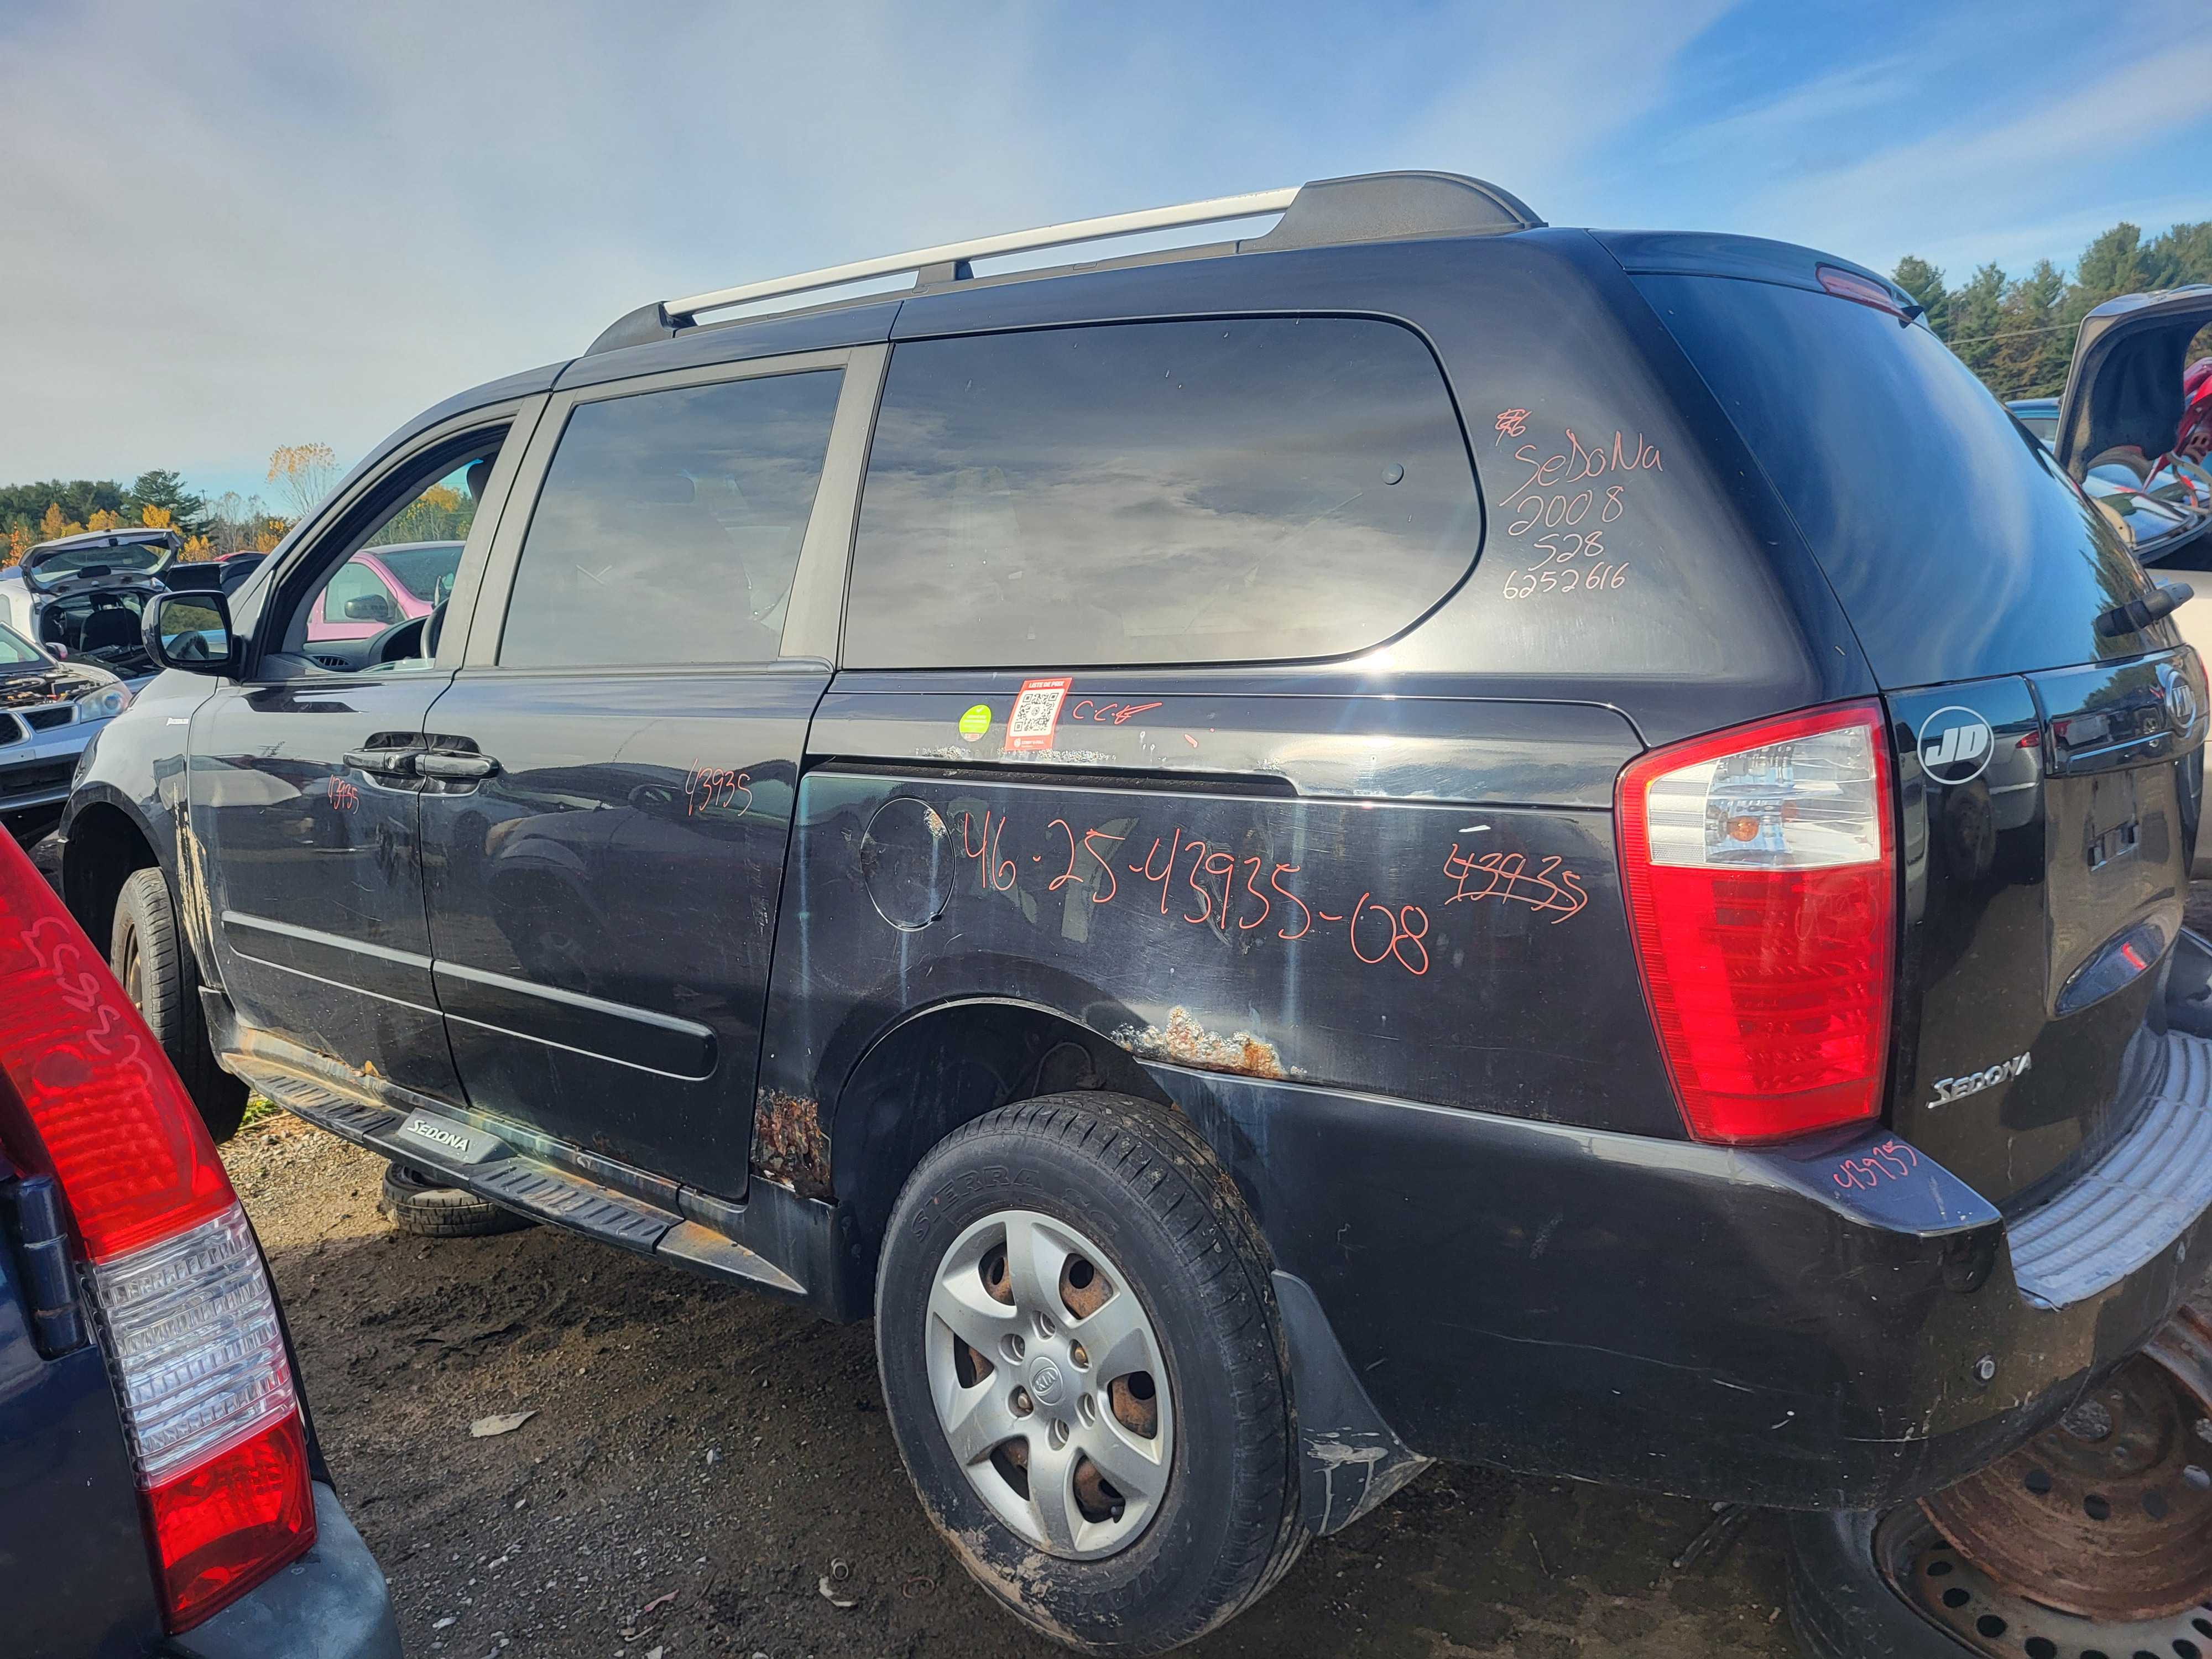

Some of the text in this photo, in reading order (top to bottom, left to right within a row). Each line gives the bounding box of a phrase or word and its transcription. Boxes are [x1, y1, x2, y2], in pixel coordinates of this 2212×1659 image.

[1507, 485, 1624, 536] 2008
[1527, 530, 1605, 571] 528
[1924, 723, 1989, 767] JD
[685, 758, 753, 816] 43935
[1443, 843, 1588, 924] 43935
[406, 1119, 470, 1152] SEDONA
[912, 1164, 1044, 1244] SIERRA
[1035, 1371, 1056, 1390] KIA
